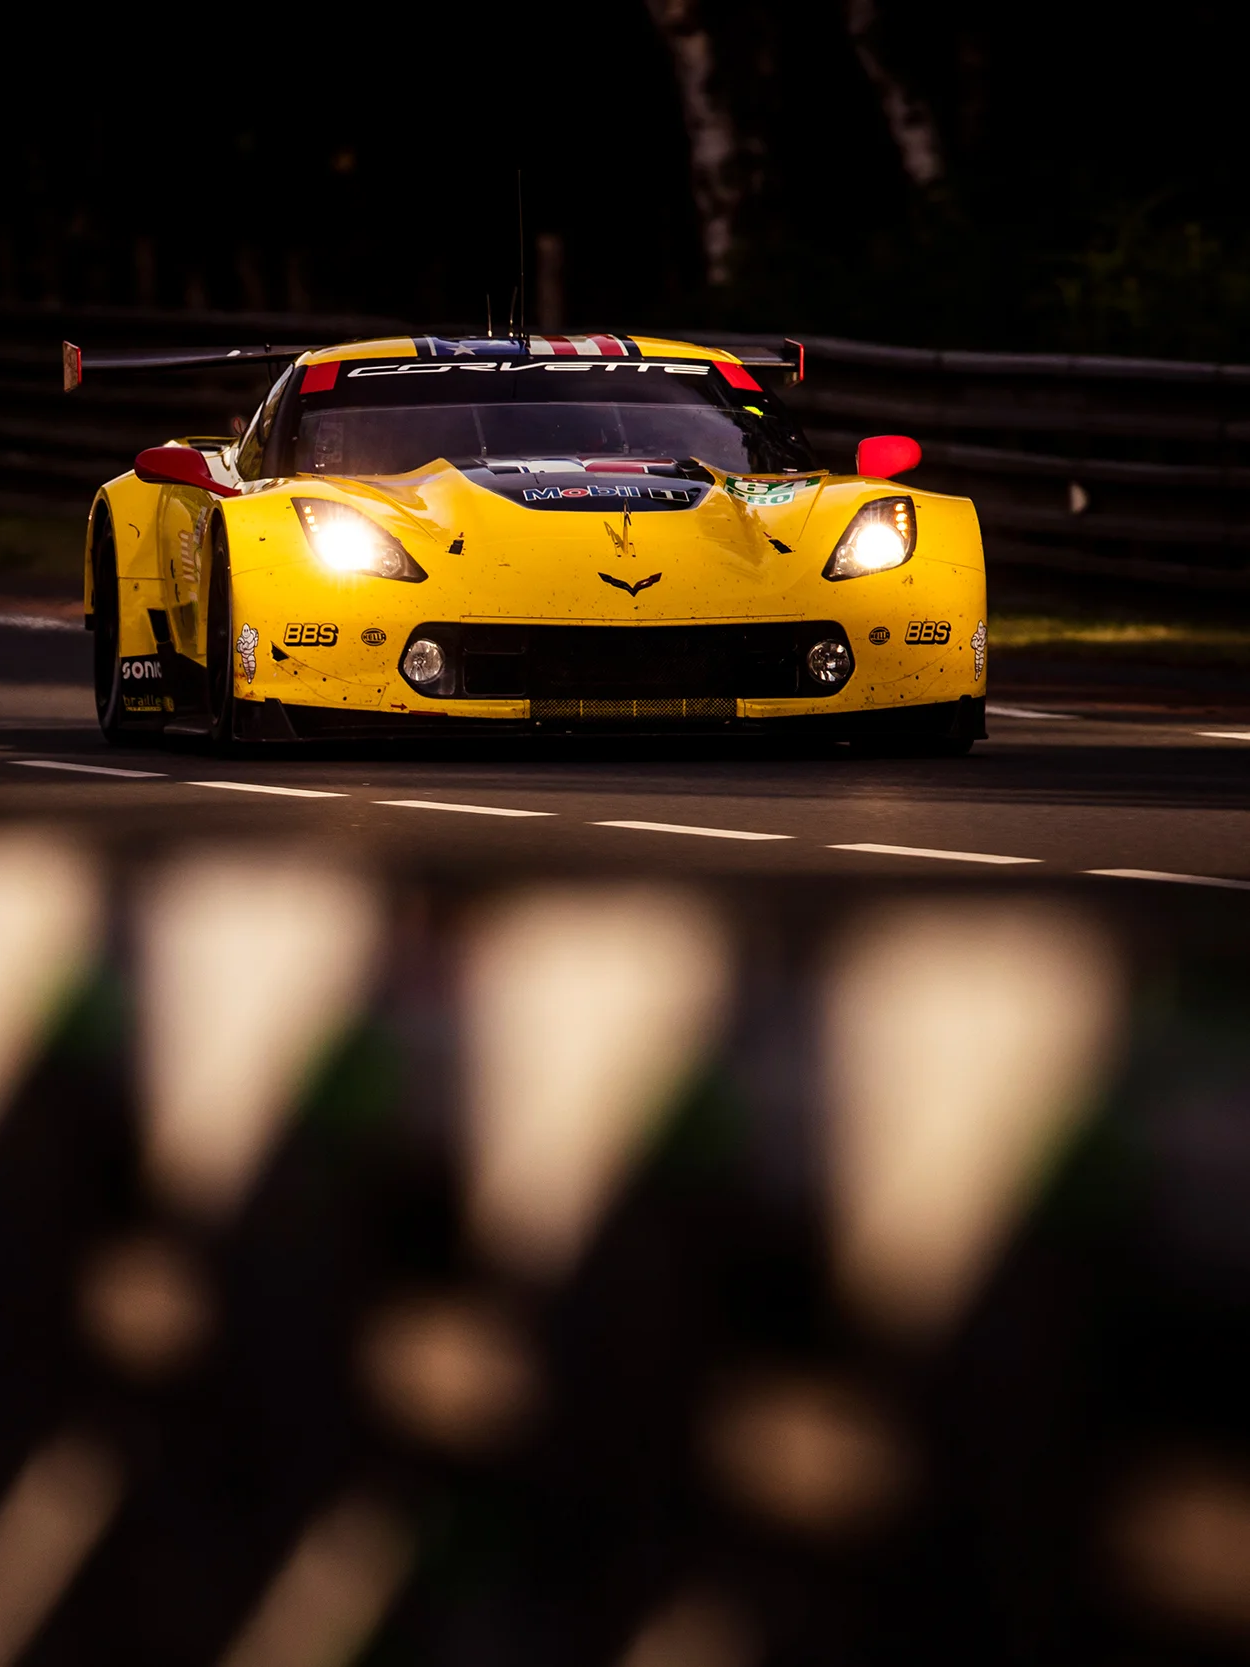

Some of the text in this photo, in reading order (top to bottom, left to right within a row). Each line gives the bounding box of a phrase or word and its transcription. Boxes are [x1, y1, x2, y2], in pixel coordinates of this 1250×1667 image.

[347, 361, 710, 378] CORVETTE
[523, 485, 641, 501] Mobil
[726, 486, 791, 504] PRO
[283, 623, 339, 647] BBS
[905, 621, 951, 645] BBS
